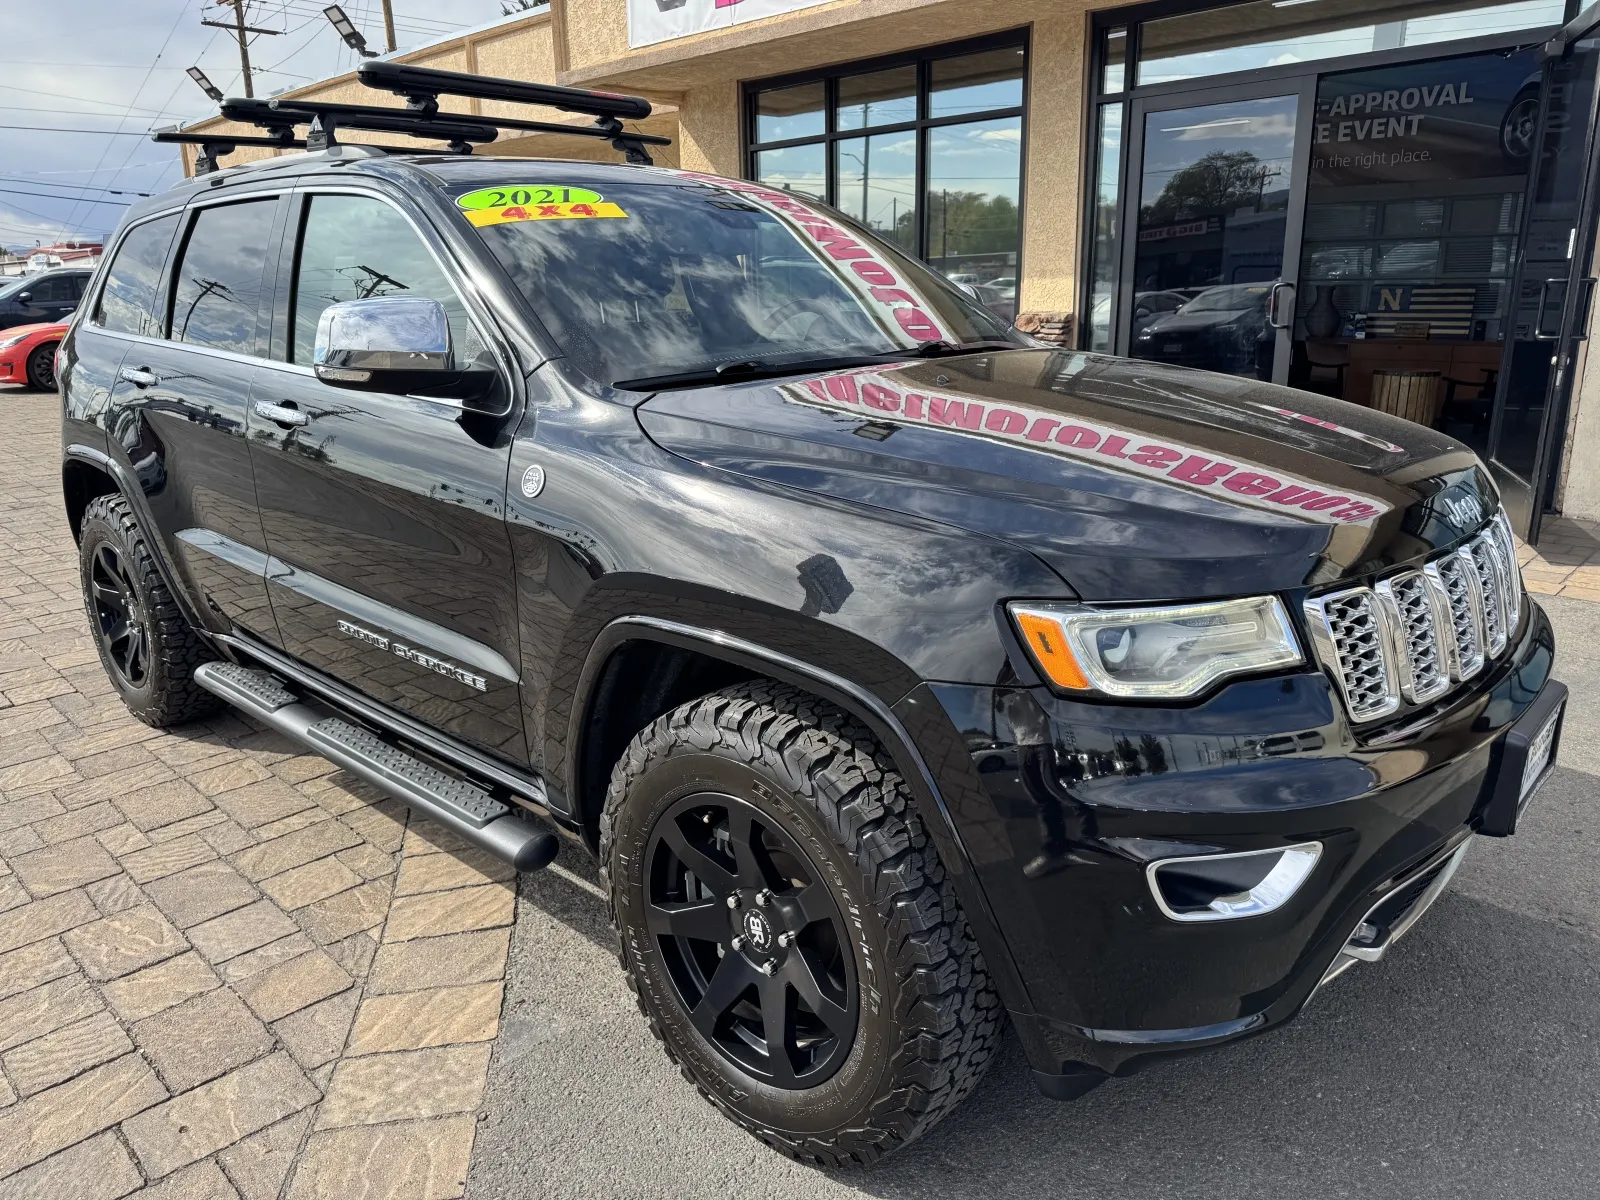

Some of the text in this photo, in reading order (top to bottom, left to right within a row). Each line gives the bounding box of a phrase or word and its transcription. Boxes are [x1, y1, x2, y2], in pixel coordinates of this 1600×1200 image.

[1315, 81, 1474, 118] -APPROVAL
[1313, 115, 1425, 144] E EVENT
[1312, 148, 1432, 169] in the right place.
[487, 188, 571, 208] 2021
[1377, 288, 1404, 311] N
[1442, 494, 1482, 528] Jeep
[336, 619, 489, 692] GRAND CHEROKEE
